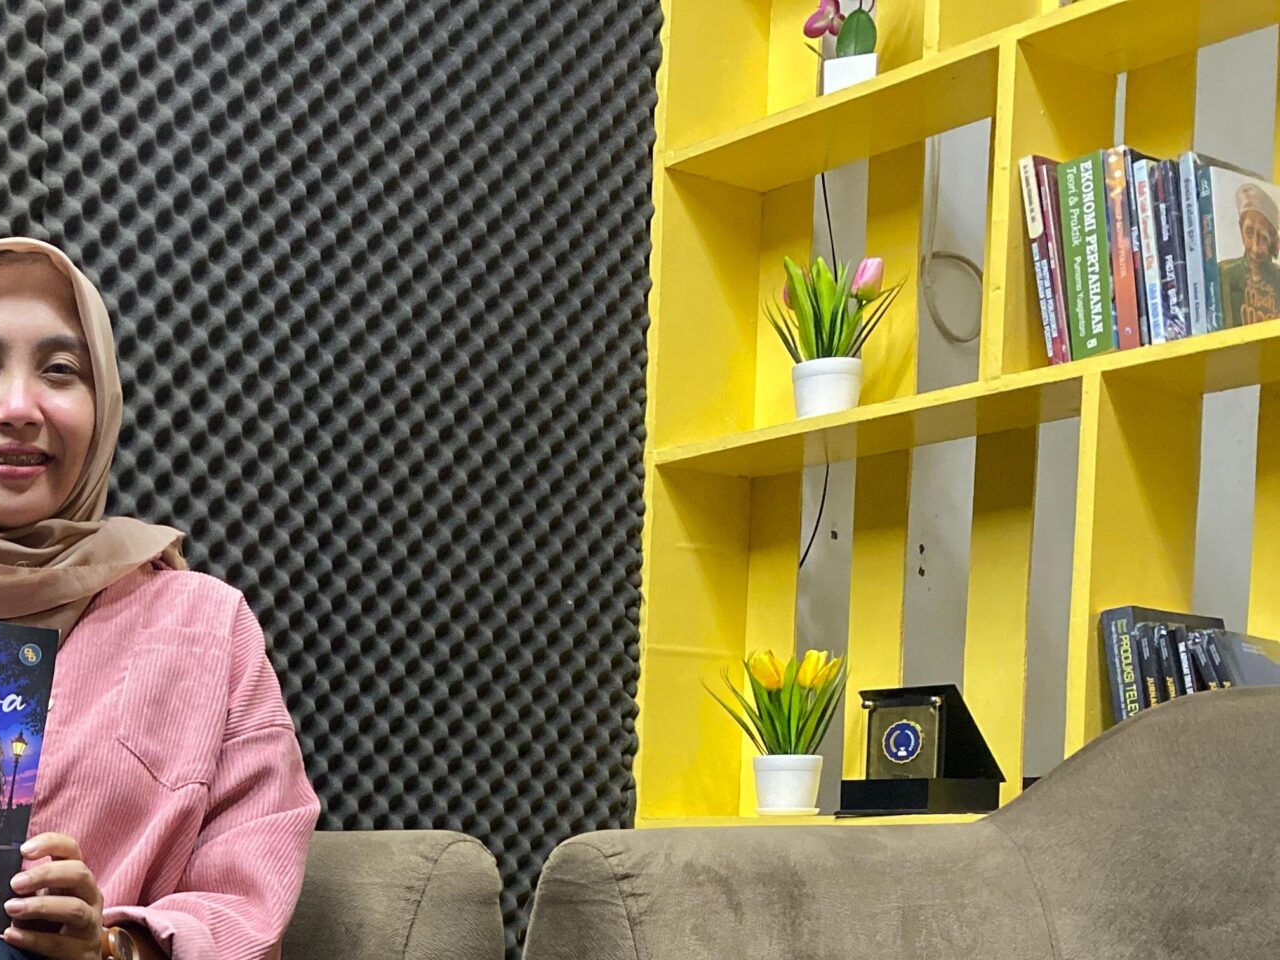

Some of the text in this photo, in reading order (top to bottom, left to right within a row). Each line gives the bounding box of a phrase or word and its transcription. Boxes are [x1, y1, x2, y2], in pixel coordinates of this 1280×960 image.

[1067, 166, 1082, 247] Teori & Praktik
[1080, 160, 1103, 334] EKONOMI PERTAHANAN
[1120, 634, 1135, 683] PRODUKSI
